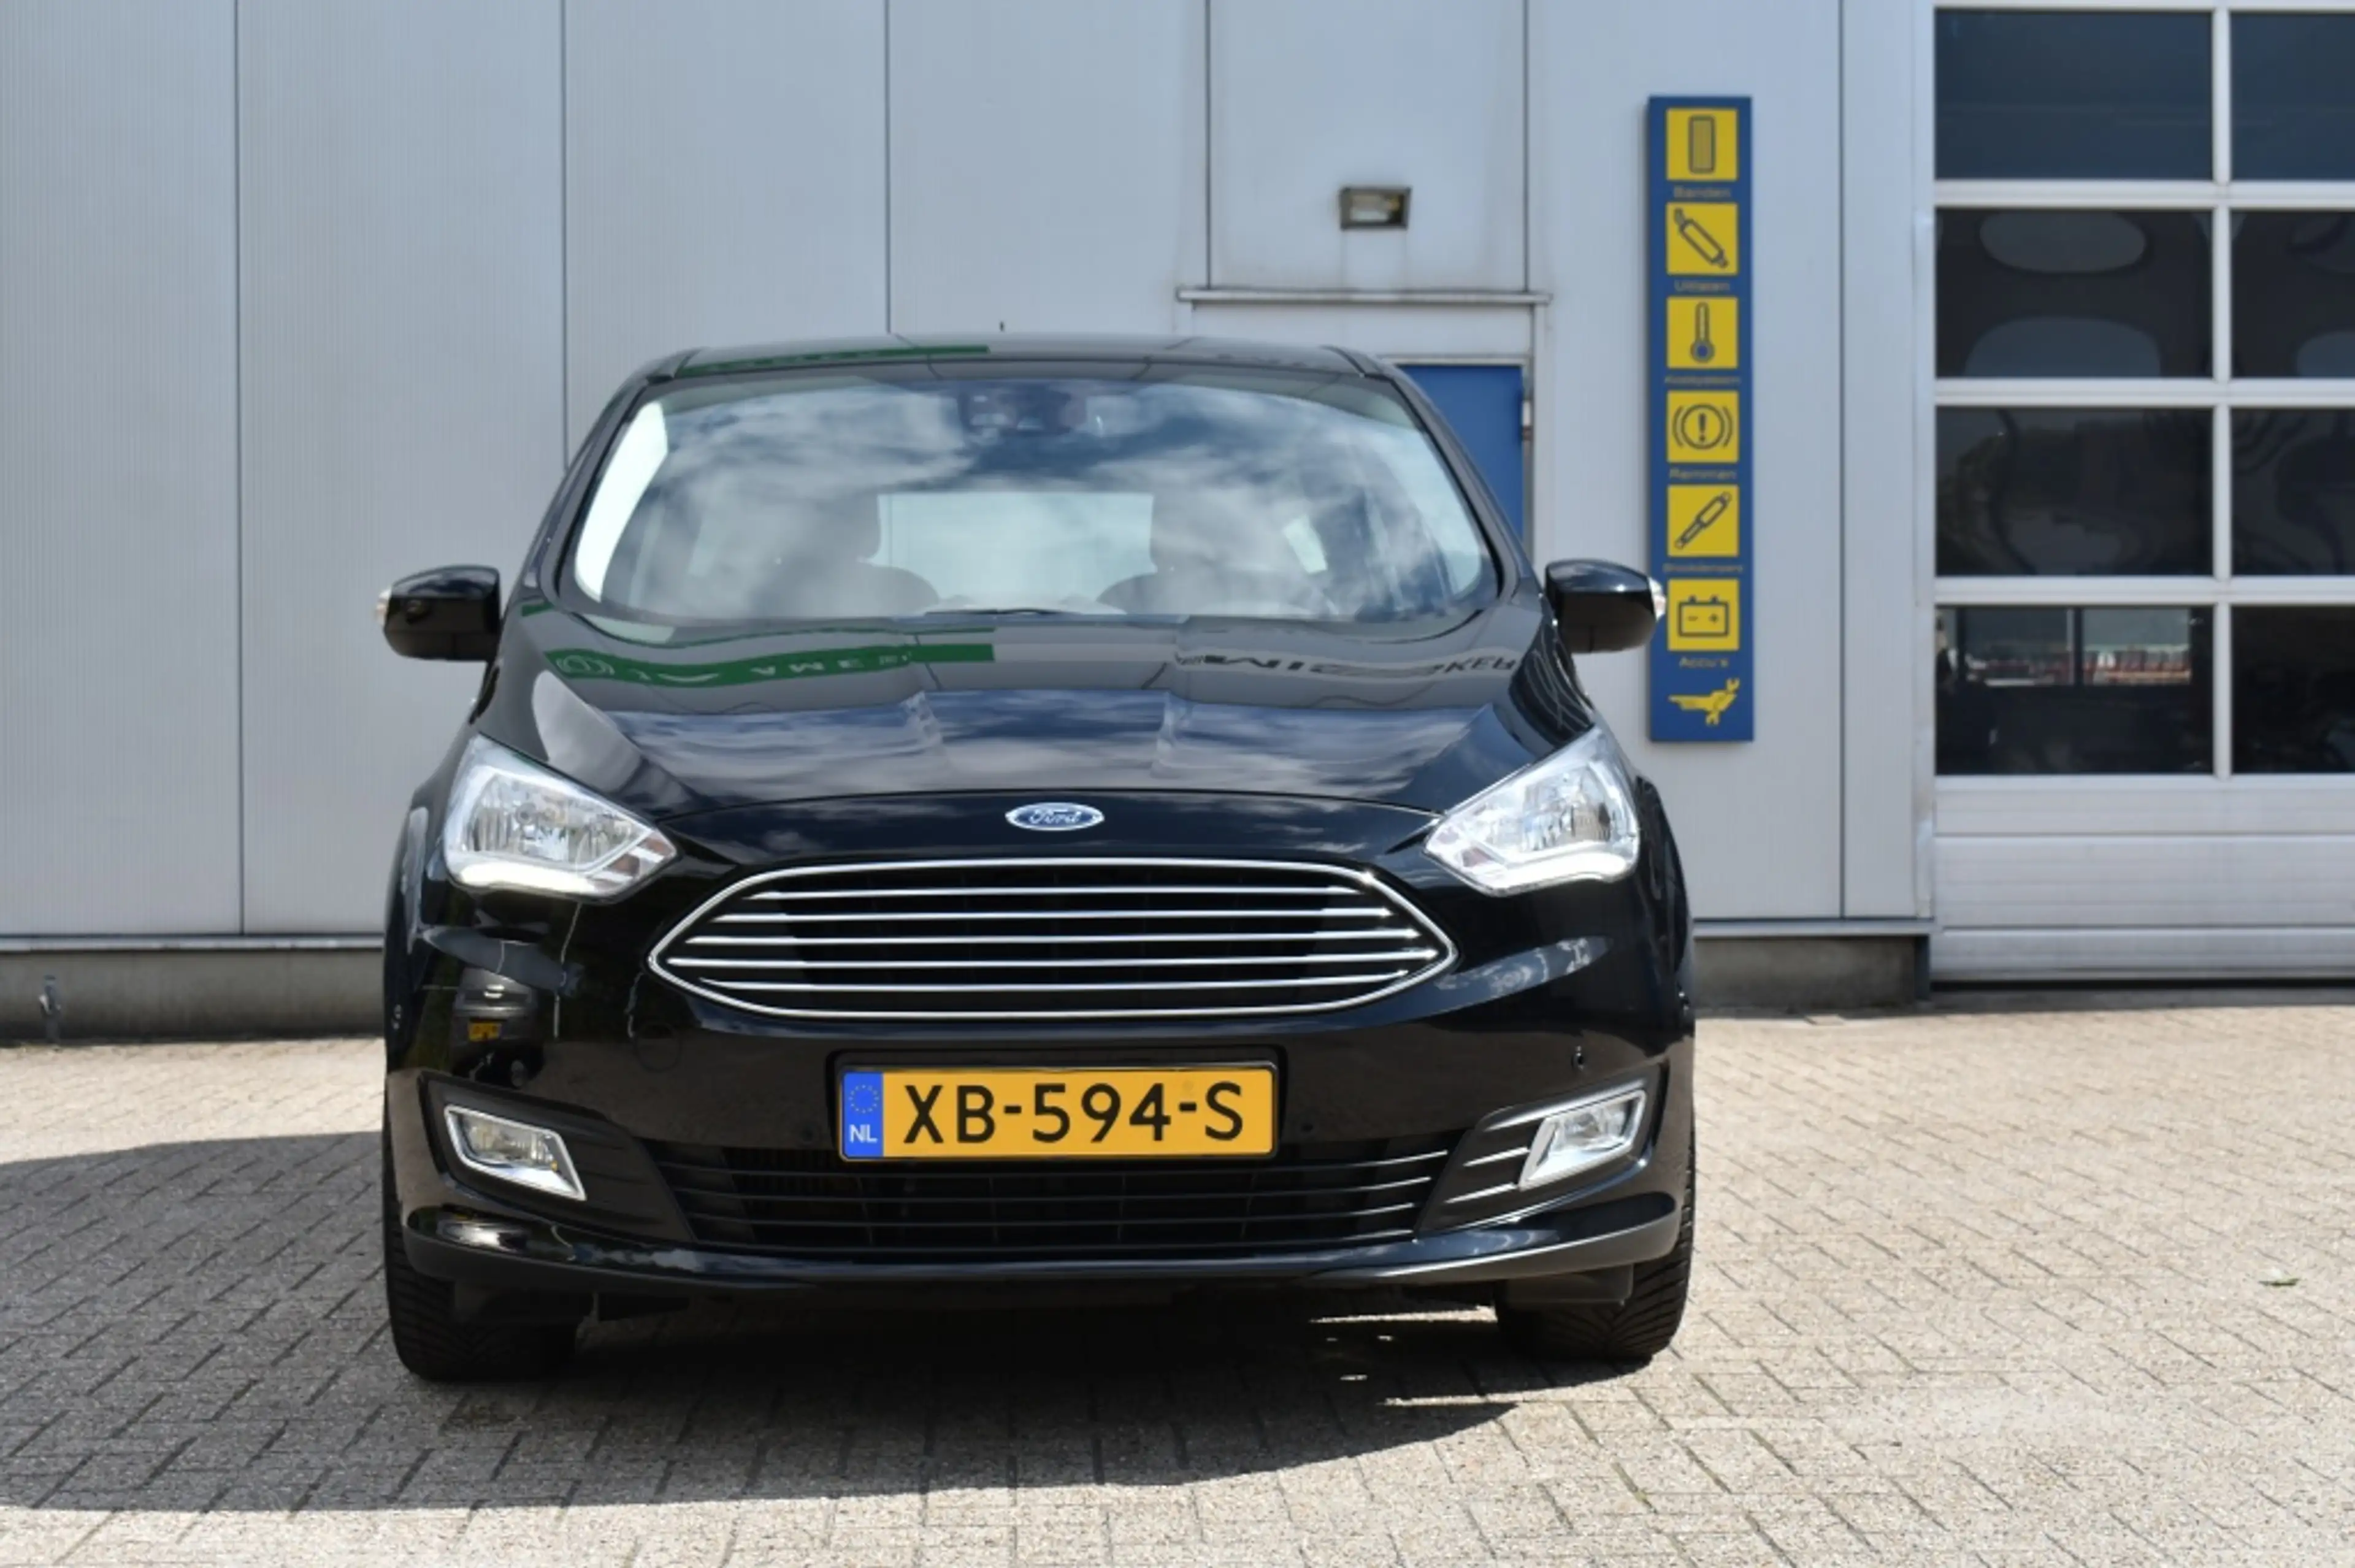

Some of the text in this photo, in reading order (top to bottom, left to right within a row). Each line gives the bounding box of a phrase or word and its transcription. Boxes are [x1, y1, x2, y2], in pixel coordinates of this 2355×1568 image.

[1028, 808, 1082, 824] Ford
[904, 1081, 1243, 1144] XB-594-S
[849, 1124, 878, 1143] NL
